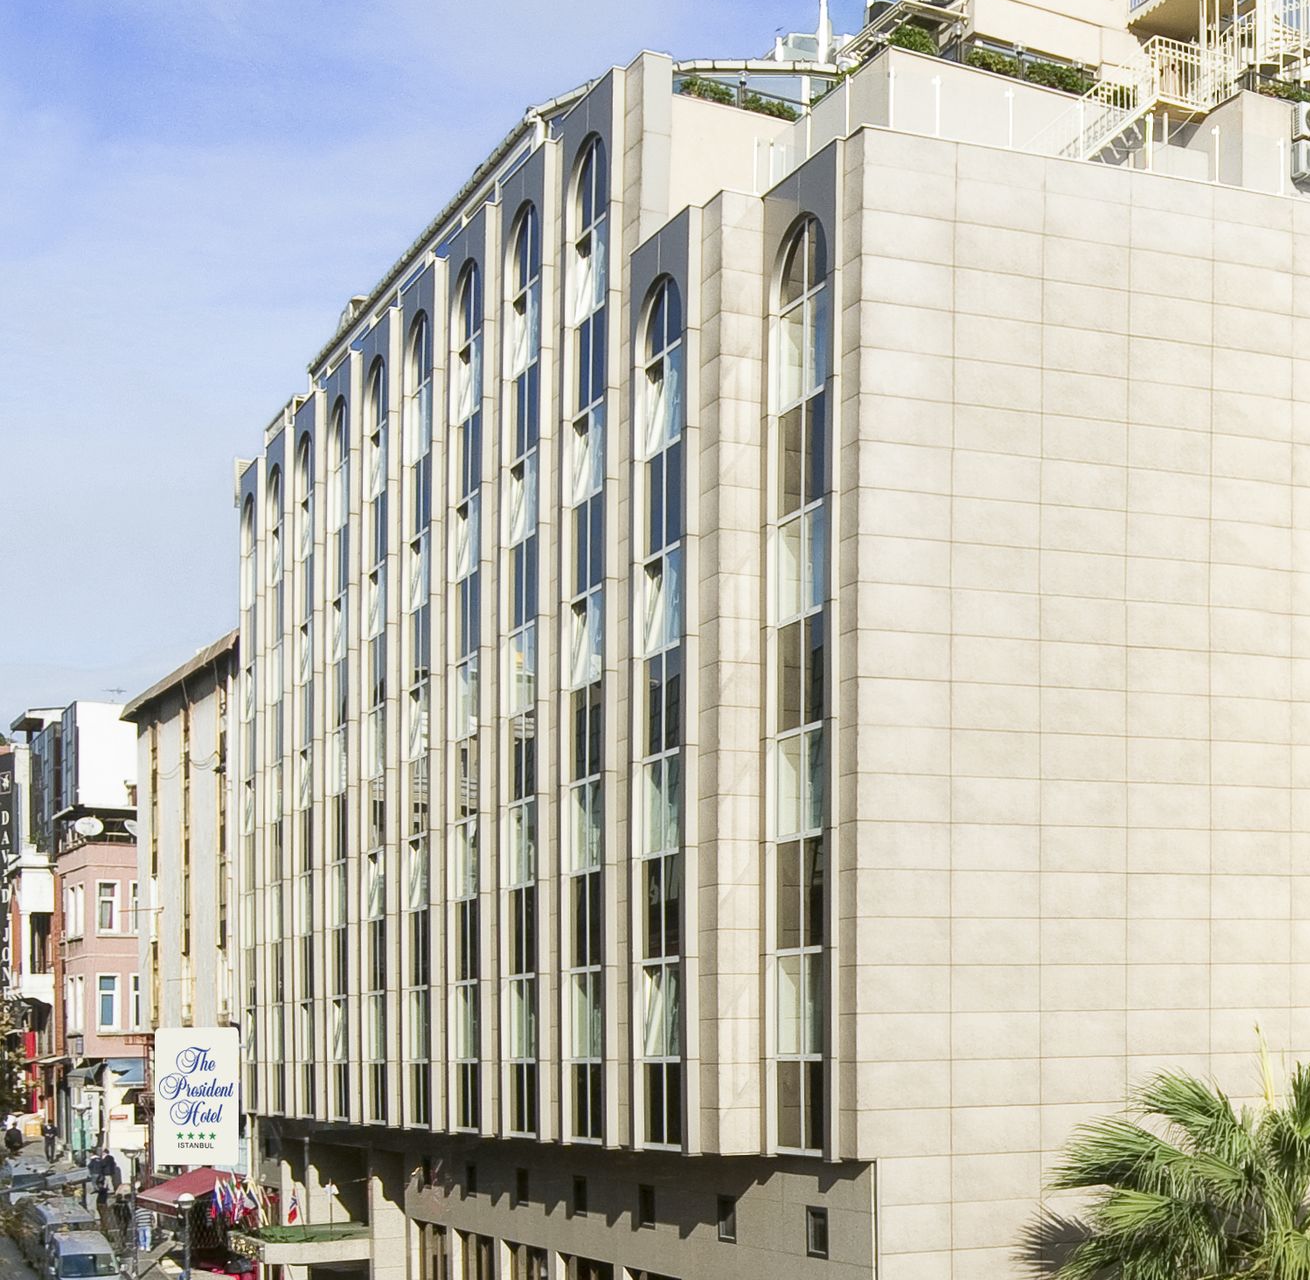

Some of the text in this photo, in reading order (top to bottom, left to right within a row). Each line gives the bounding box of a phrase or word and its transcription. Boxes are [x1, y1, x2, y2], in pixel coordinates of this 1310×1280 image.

[176, 1047, 216, 1074] The
[159, 1073, 234, 1100] President
[170, 1099, 224, 1127] Hotel
[178, 1141, 214, 1149] ISTANBUL
